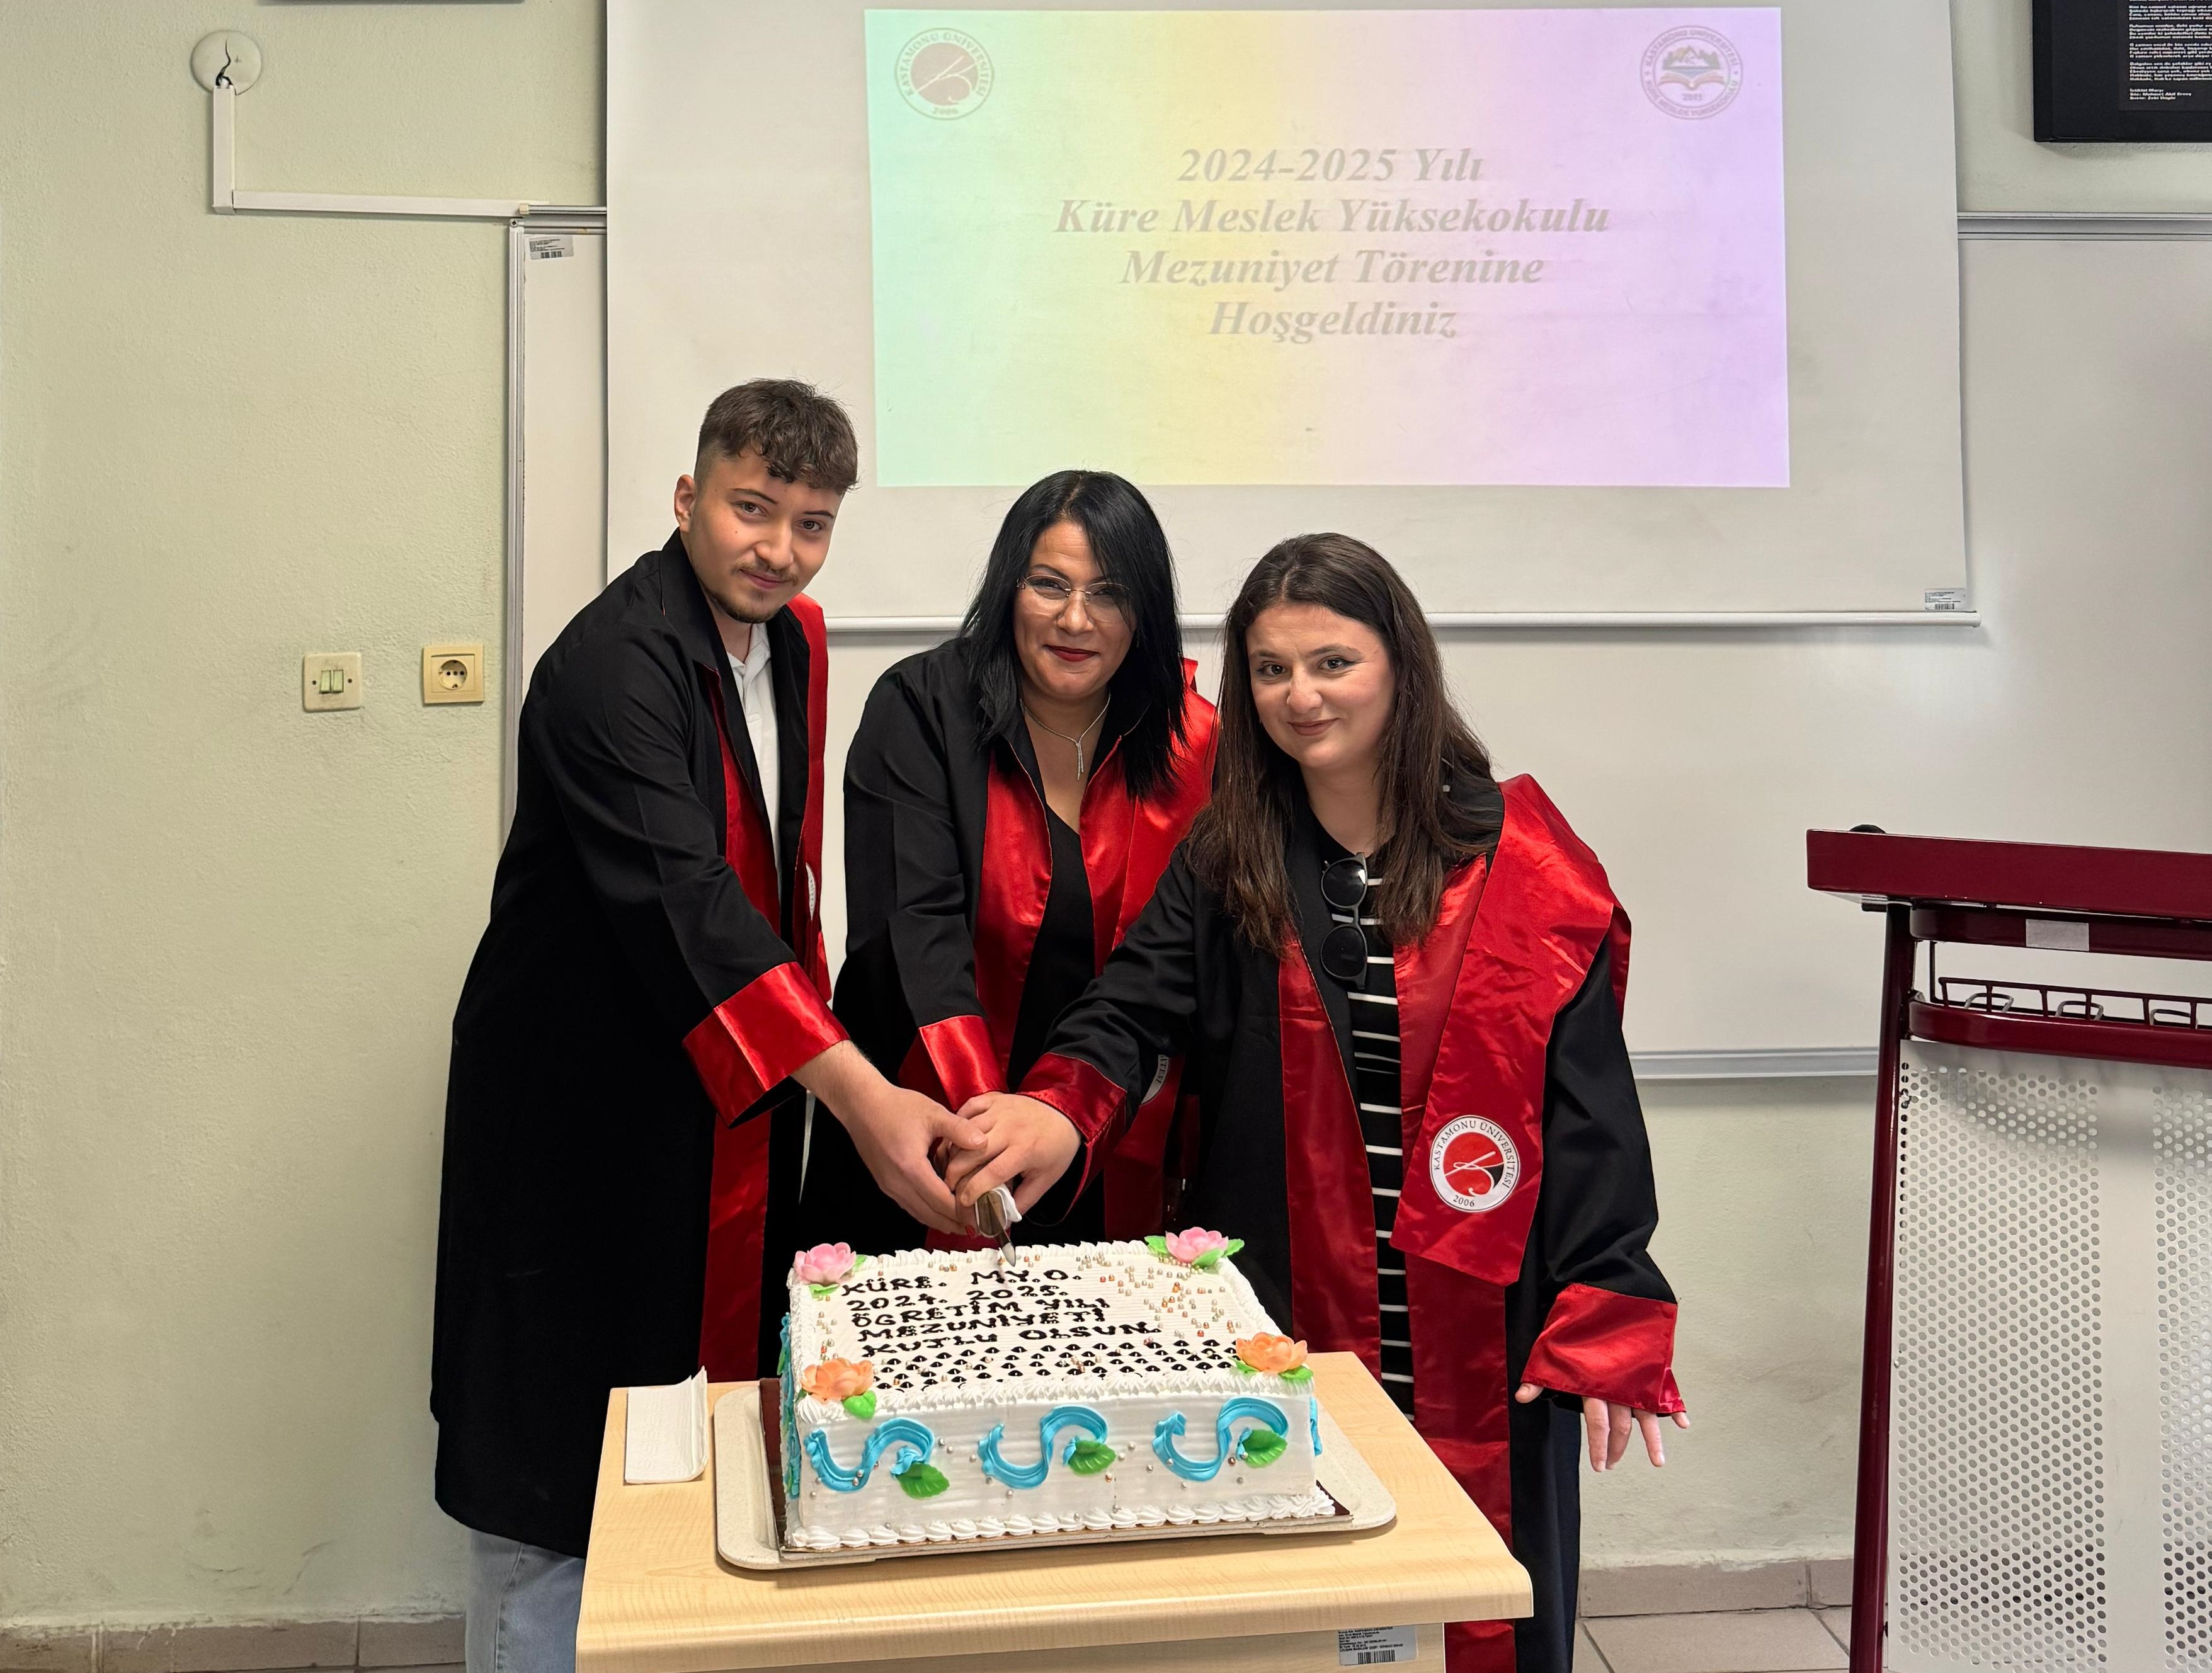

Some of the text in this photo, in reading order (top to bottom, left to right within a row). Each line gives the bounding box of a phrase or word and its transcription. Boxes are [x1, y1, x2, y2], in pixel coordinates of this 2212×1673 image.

[1177, 147, 1485, 182] 2024-2025 Yılı
[1052, 198, 1611, 233] Küre Meslek Yüksekokulu
[1119, 248, 1544, 292] Mezuniyet Törenine
[1207, 300, 1457, 344] Hoşgeldiniz
[1434, 1120, 1476, 1171] KASTAMONU
[1453, 1194, 1475, 1208] 2006
[861, 1333, 998, 1358] KUTLU
